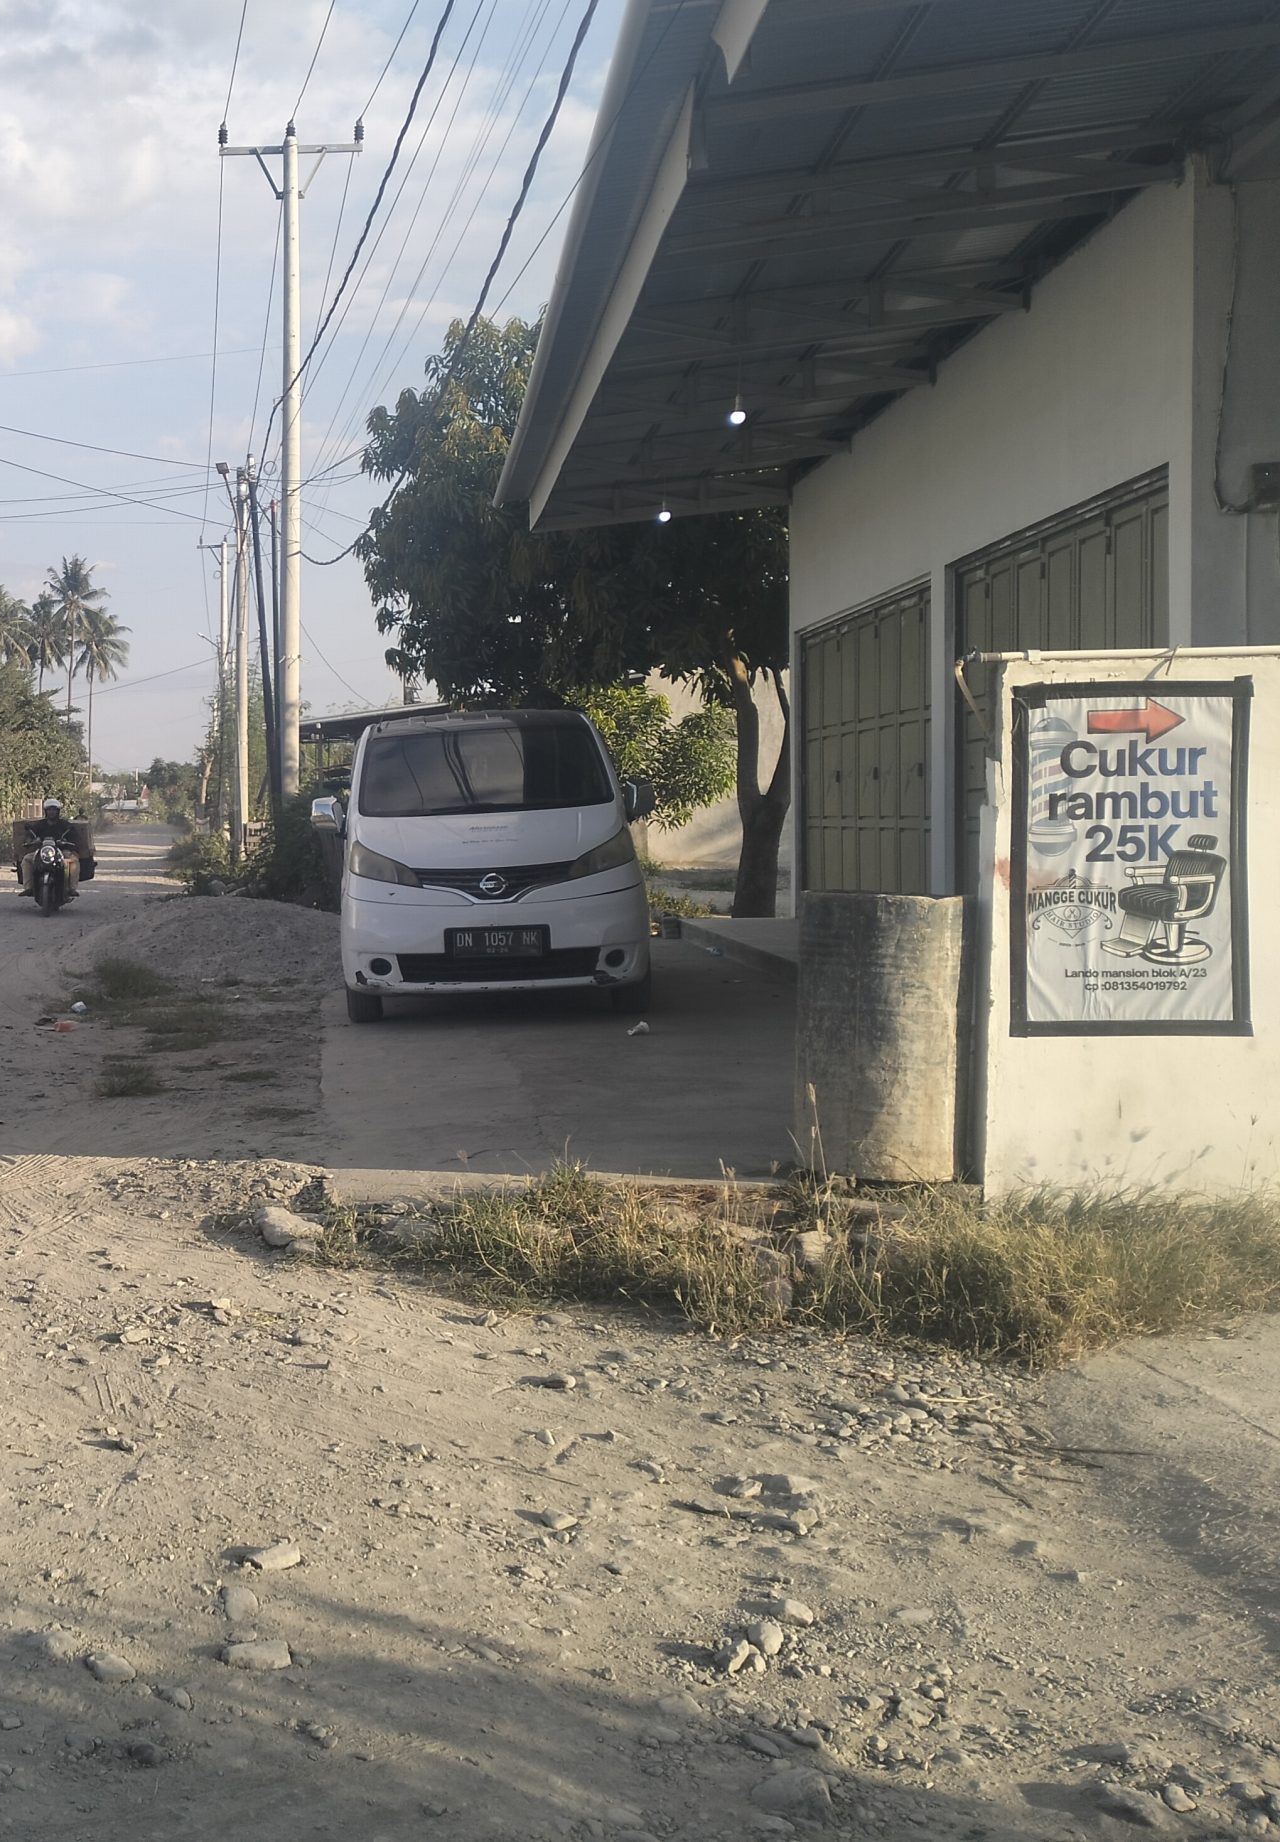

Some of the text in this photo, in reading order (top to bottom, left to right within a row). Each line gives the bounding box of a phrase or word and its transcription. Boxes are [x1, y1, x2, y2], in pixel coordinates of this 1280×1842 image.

[1060, 740, 1207, 778] Cukur
[1048, 781, 1218, 820] rambut
[1085, 824, 1181, 862] 25K
[1028, 891, 1116, 914] MANGGE CUKUR
[1046, 911, 1099, 929] HAIR STUDIO
[456, 930, 539, 947] DN 1057 NK
[1064, 968, 1208, 979] Lando mansion blok A/23
[1084, 983, 1099, 993] cp
